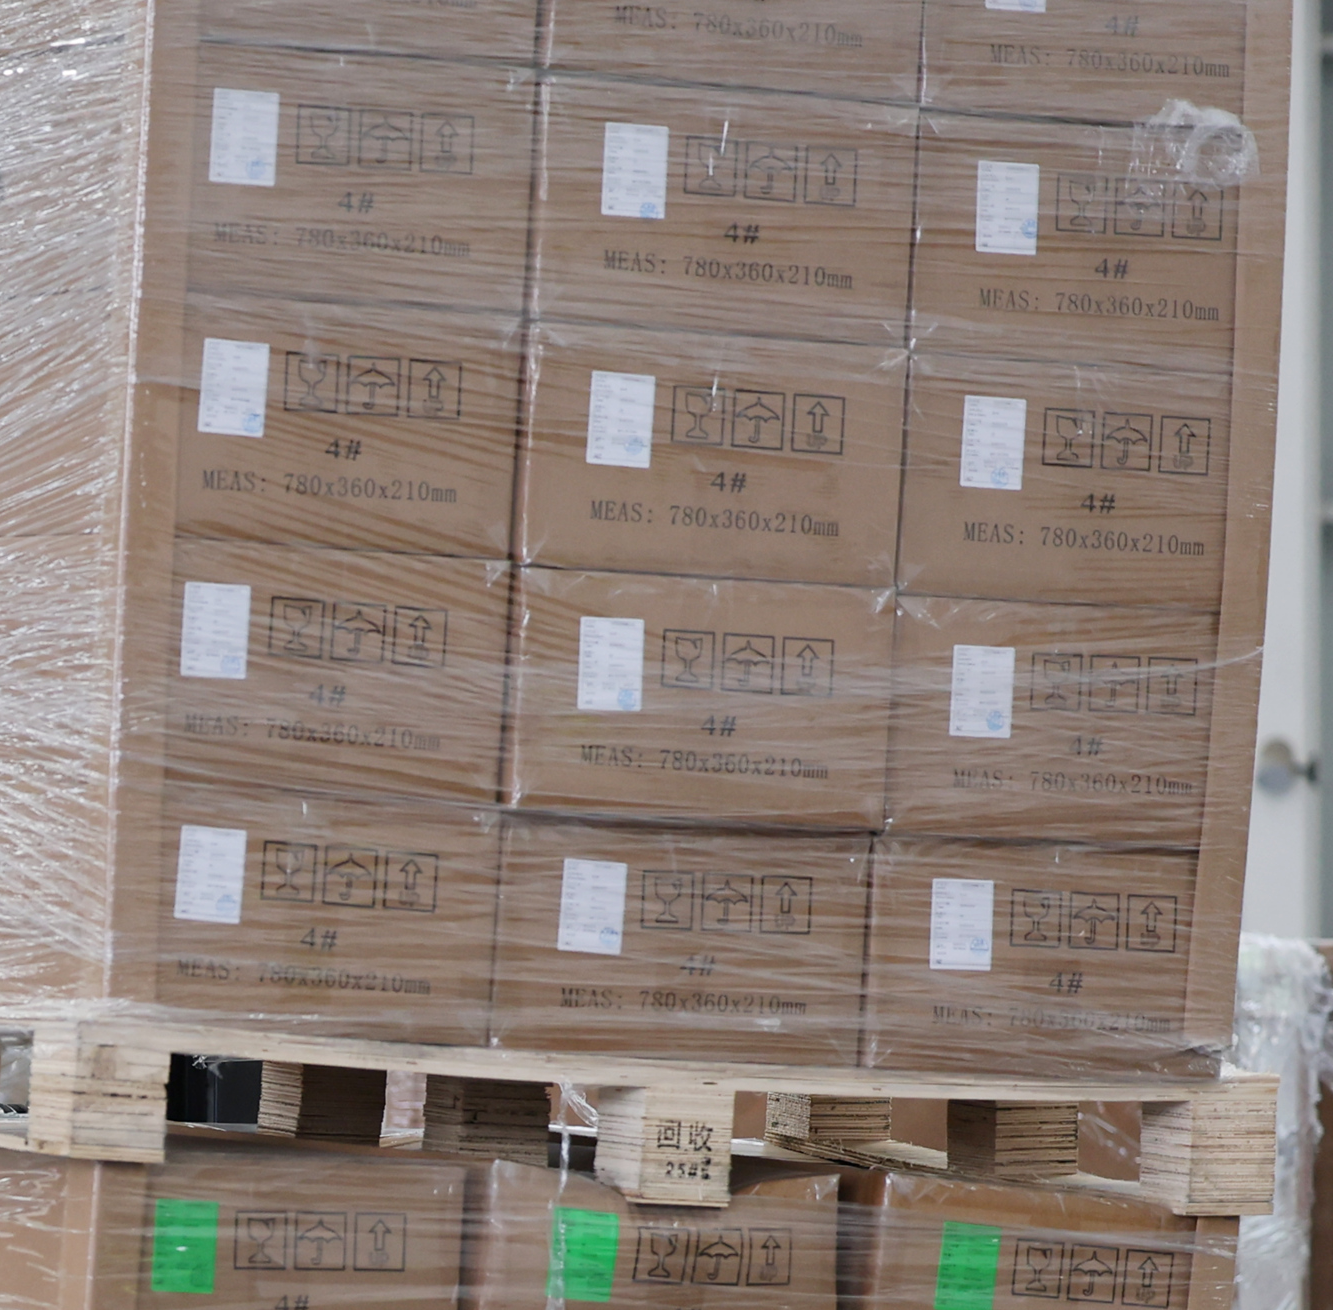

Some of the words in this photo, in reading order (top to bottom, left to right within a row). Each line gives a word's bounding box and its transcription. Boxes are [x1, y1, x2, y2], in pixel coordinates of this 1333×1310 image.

[615, 6, 677, 30] MEAS:
[1105, 16, 1140, 36] 4#
[990, 44, 1053, 67] MEAS:
[1067, 48, 1231, 78] 780x360x210mm
[337, 192, 375, 214] 4#
[214, 222, 280, 247] MEAS:
[295, 227, 471, 258] 780x360x210mm
[724, 222, 760, 245] 4#
[603, 249, 667, 274] MEAS:
[683, 255, 854, 290] 780x360x210mm
[1094, 257, 1129, 279] 4#
[979, 288, 1039, 311] MEAS:
[1055, 292, 1220, 322] 780x360x210mm
[325, 439, 361, 460] 4#
[203, 470, 267, 493] MEAS:
[284, 473, 457, 503] 780x360x210mm
[711, 472, 746, 493] 4#
[1081, 494, 1115, 514] 4#
[590, 500, 653, 524] MEAS:
[669, 505, 839, 537] 780x360x210mm
[963, 521, 1024, 544] MEAS:
[1041, 526, 1204, 556] 780x360x210mm
[309, 684, 346, 706] 4#
[184, 714, 248, 736] MEAS:
[701, 715, 736, 736] 4#
[1070, 736, 1103, 756] 4#
[581, 745, 643, 769] MEAS:
[660, 749, 828, 779] 780x360x210mm
[954, 769, 1014, 789] MEAS:
[1030, 771, 1192, 796] 780x360x210mm
[300, 928, 337, 951] 4#
[176, 958, 240, 981] MEAS:
[1049, 972, 1083, 993] 4#
[560, 987, 623, 1010] MEAS:
[639, 990, 807, 1016] 780x360x210mm
[933, 1005, 993, 1027] MEAS:
[657, 1119, 714, 1152] 回收
